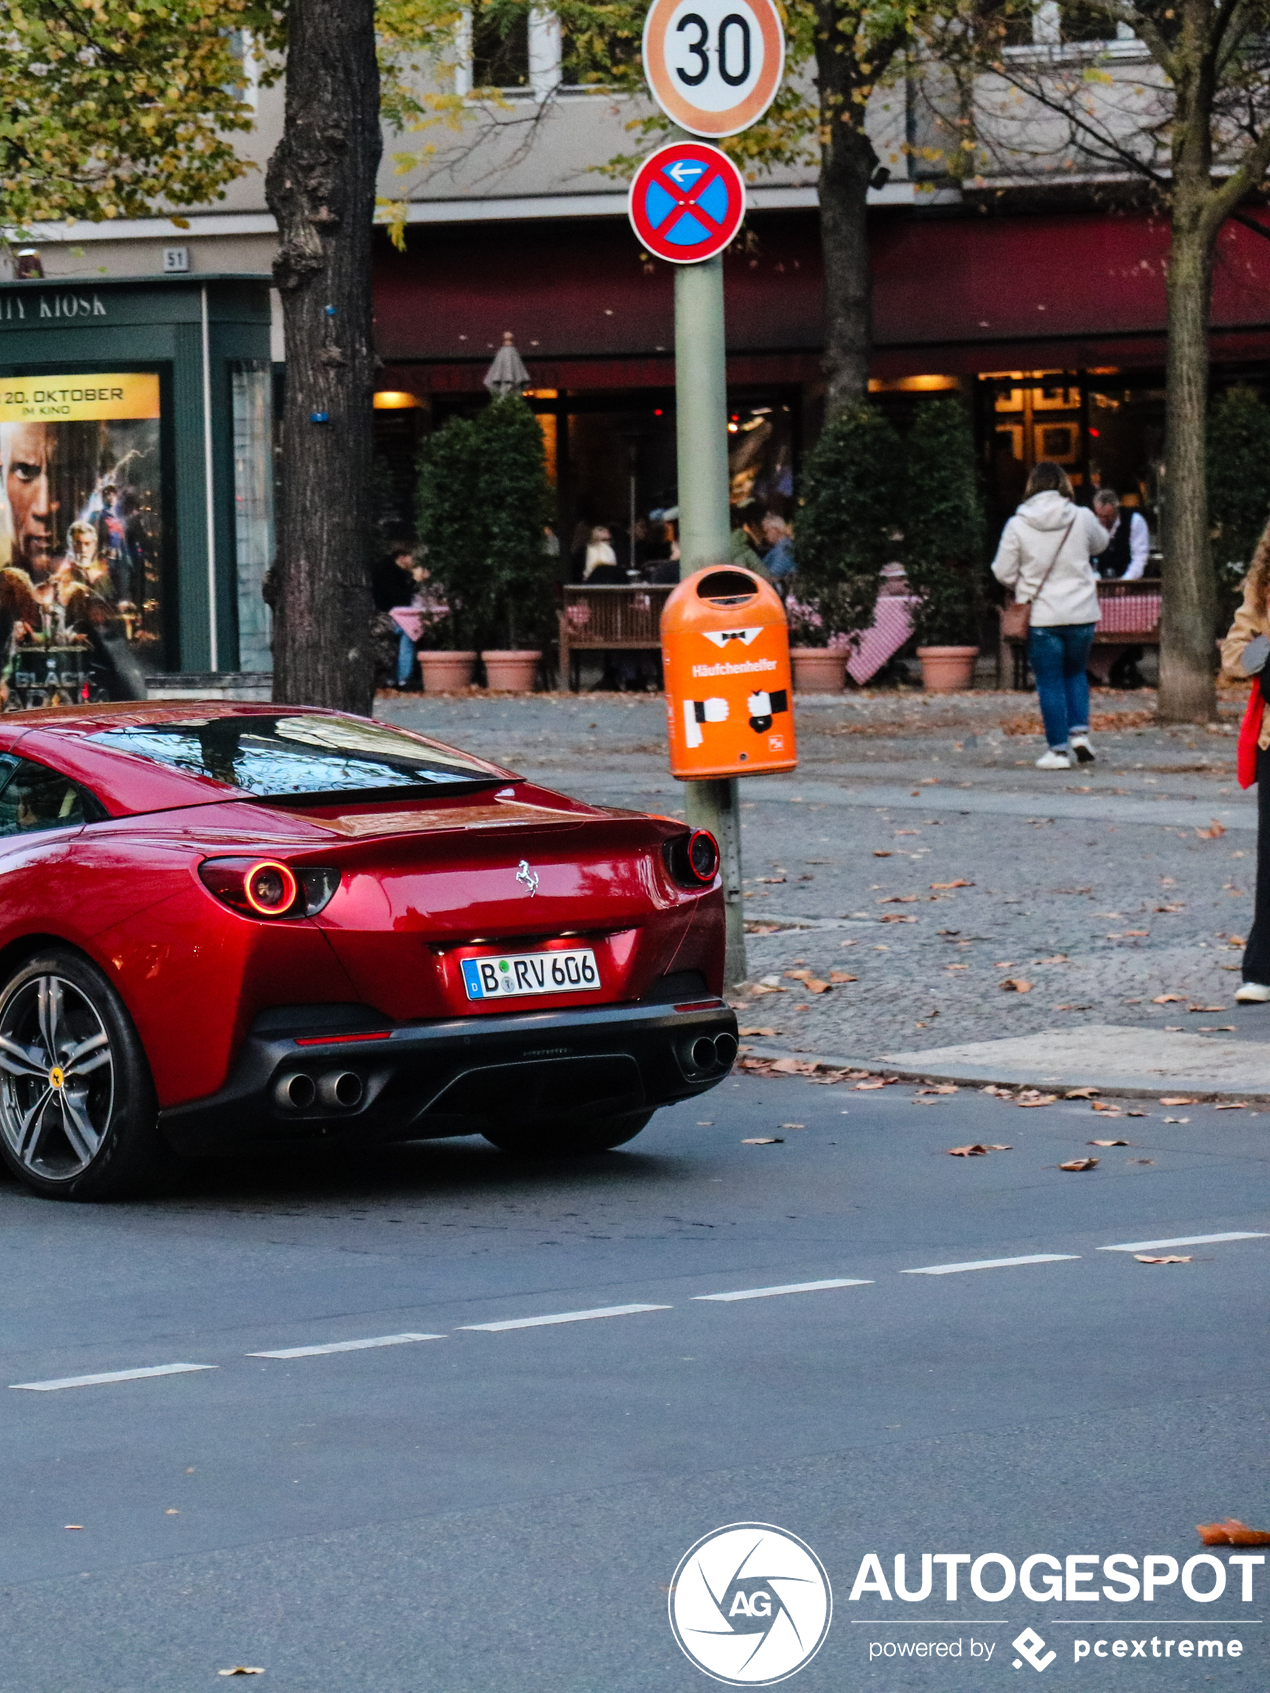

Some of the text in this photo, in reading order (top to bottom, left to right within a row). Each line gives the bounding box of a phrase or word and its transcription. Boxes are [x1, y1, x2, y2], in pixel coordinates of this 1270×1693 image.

[676, 12, 751, 87] 30
[167, 252, 184, 267] 51
[39, 293, 107, 318] KIOSK
[5, 391, 28, 405] 20.
[33, 388, 124, 404] OKTOBER
[22, 405, 71, 416] IM KINO
[692, 658, 778, 678] Häufchenhelfer
[15, 671, 98, 688] BLACK
[481, 955, 595, 993] B RV 606
[471, 982, 479, 992] D
